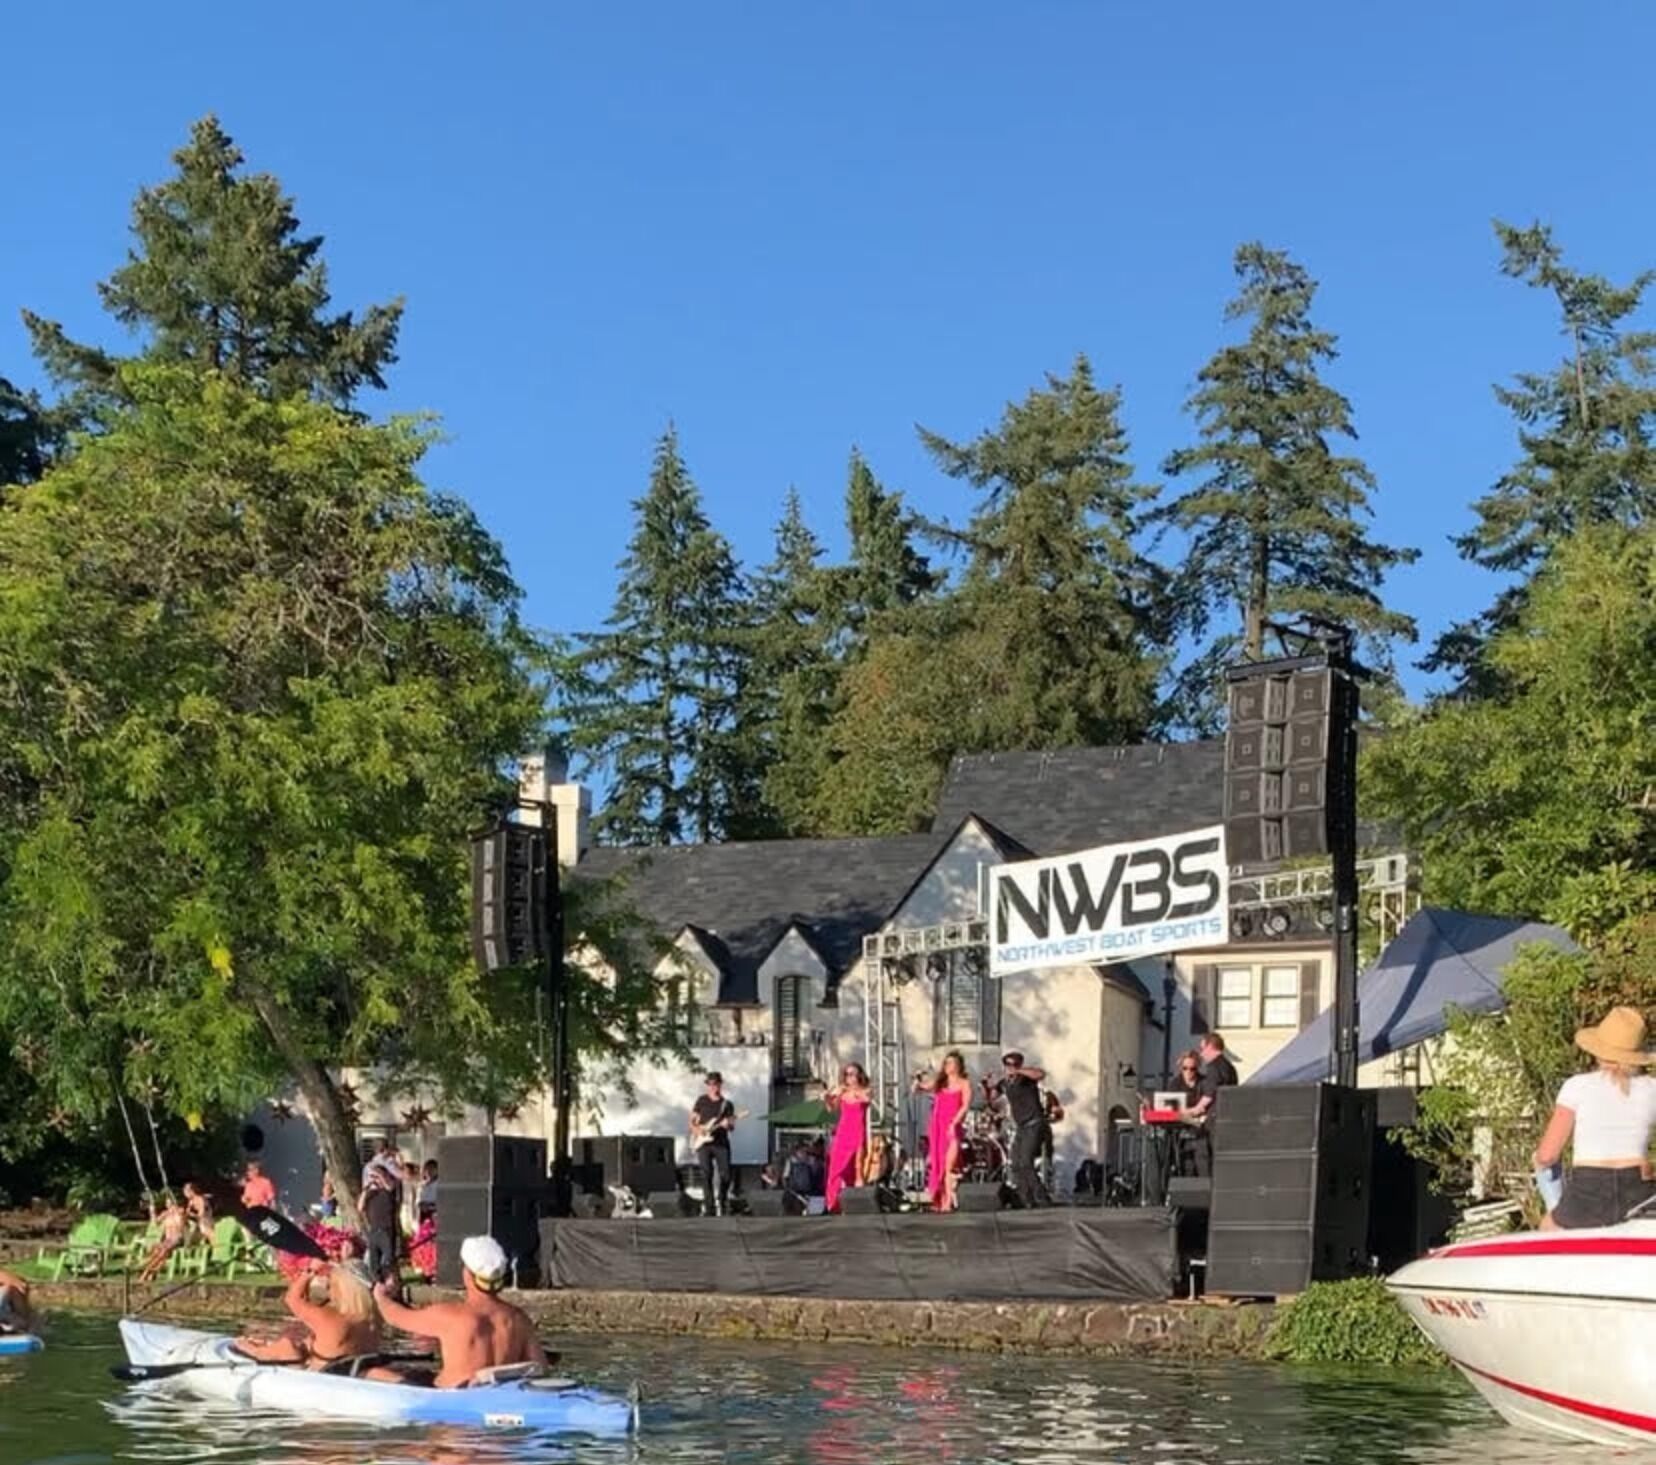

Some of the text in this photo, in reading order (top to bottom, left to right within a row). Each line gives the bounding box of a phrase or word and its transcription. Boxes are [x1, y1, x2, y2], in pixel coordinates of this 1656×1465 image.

[998, 838, 1219, 944] NWBS
[998, 918, 1220, 961] NORTHWEST BOAT SPORTS
